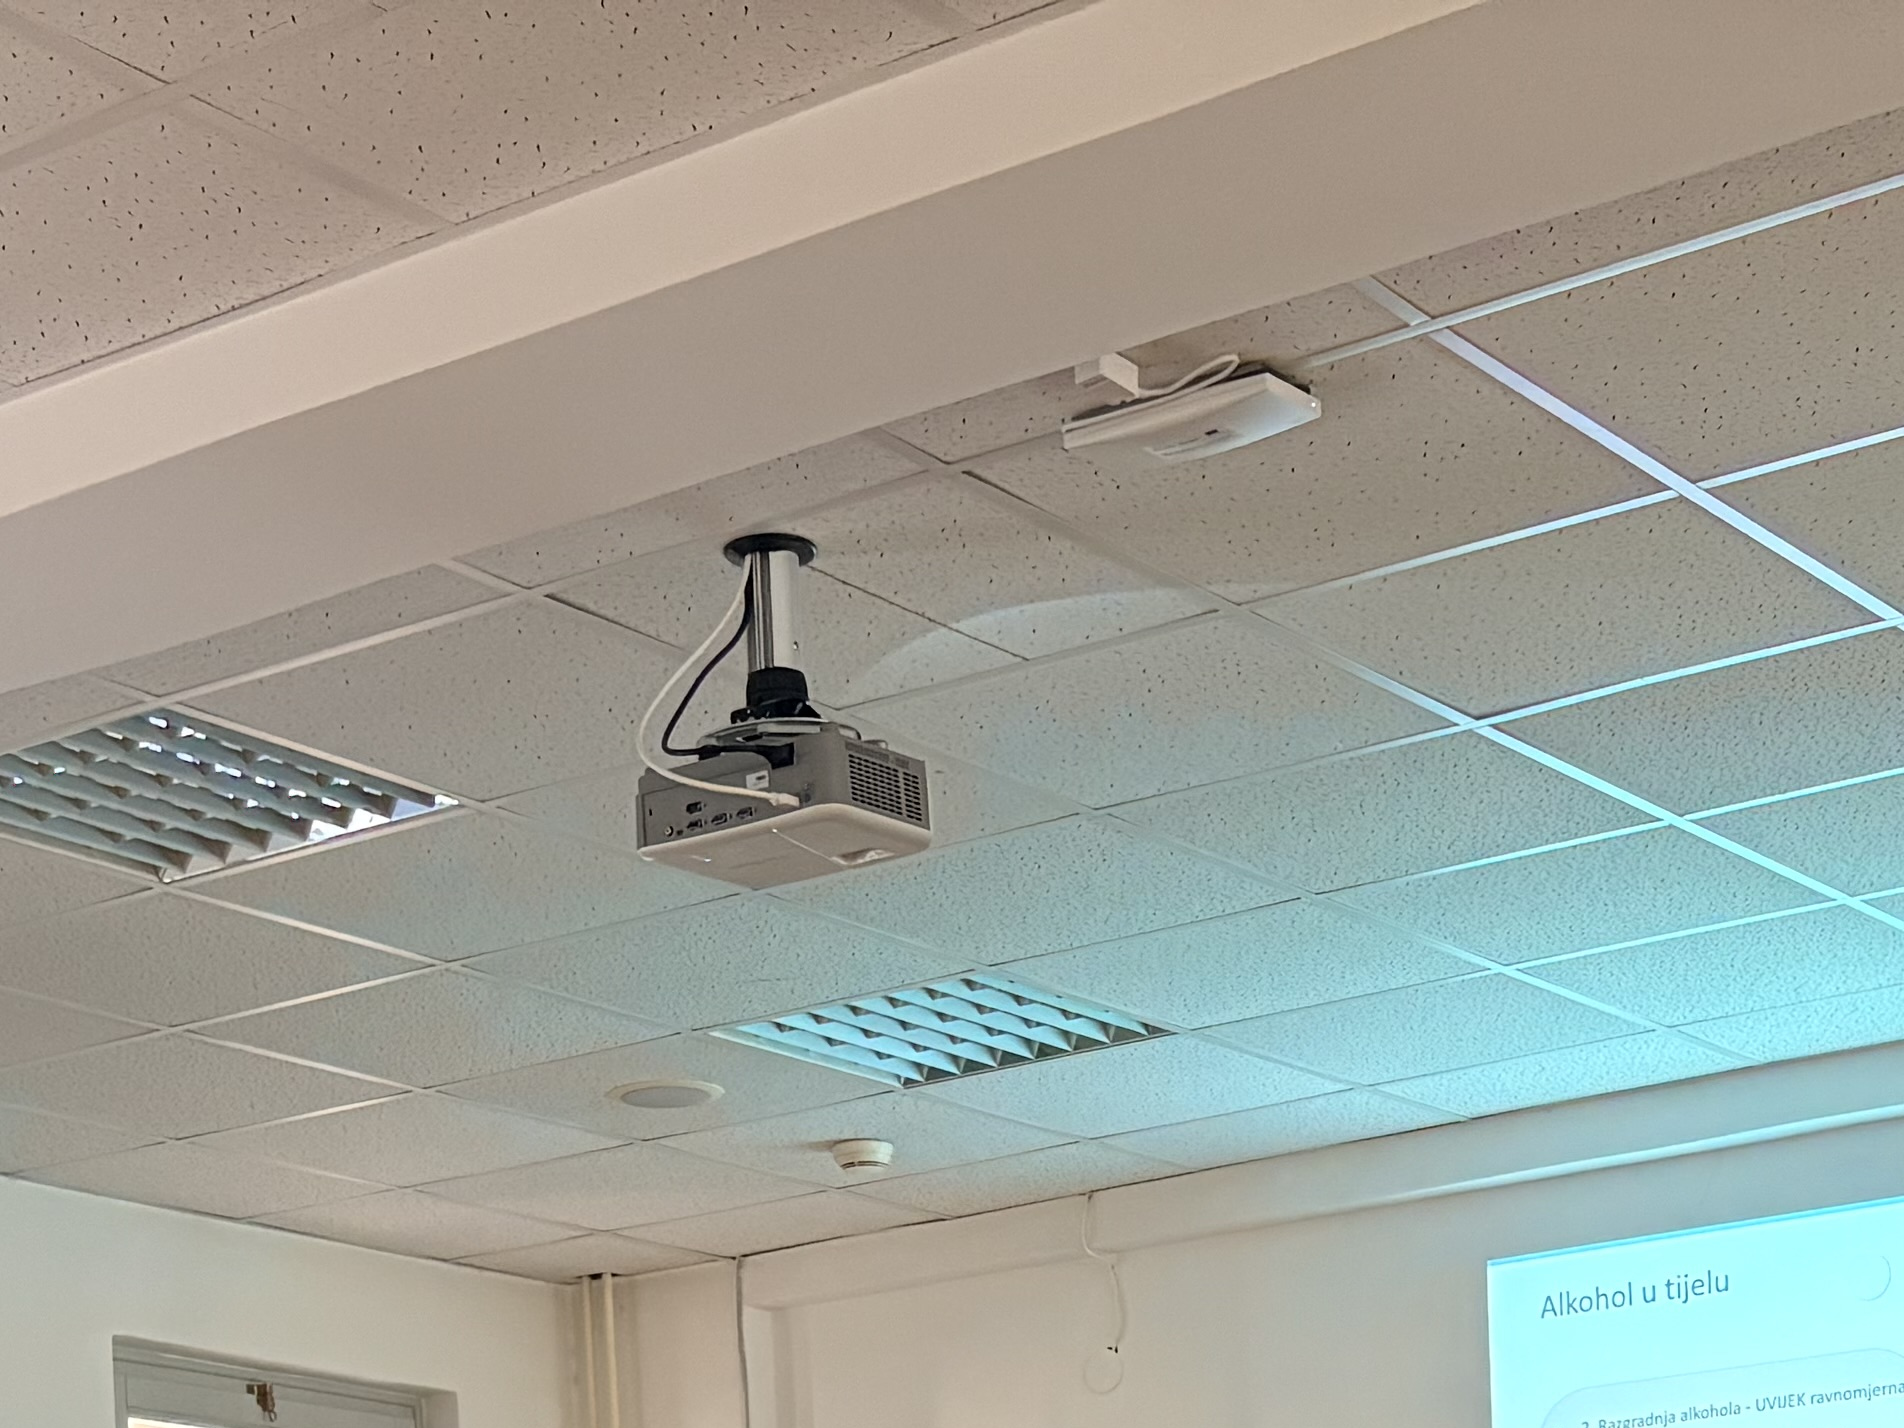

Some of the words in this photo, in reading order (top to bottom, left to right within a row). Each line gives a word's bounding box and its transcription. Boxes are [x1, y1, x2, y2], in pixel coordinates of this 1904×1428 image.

[1541, 1282, 1632, 1318] Alkohol
[1642, 1285, 1656, 1303] u
[1665, 1270, 1729, 1304] tijelu
[1680, 1401, 1741, 1422] alkohola
[1755, 1392, 1807, 1412] UVIJEK
